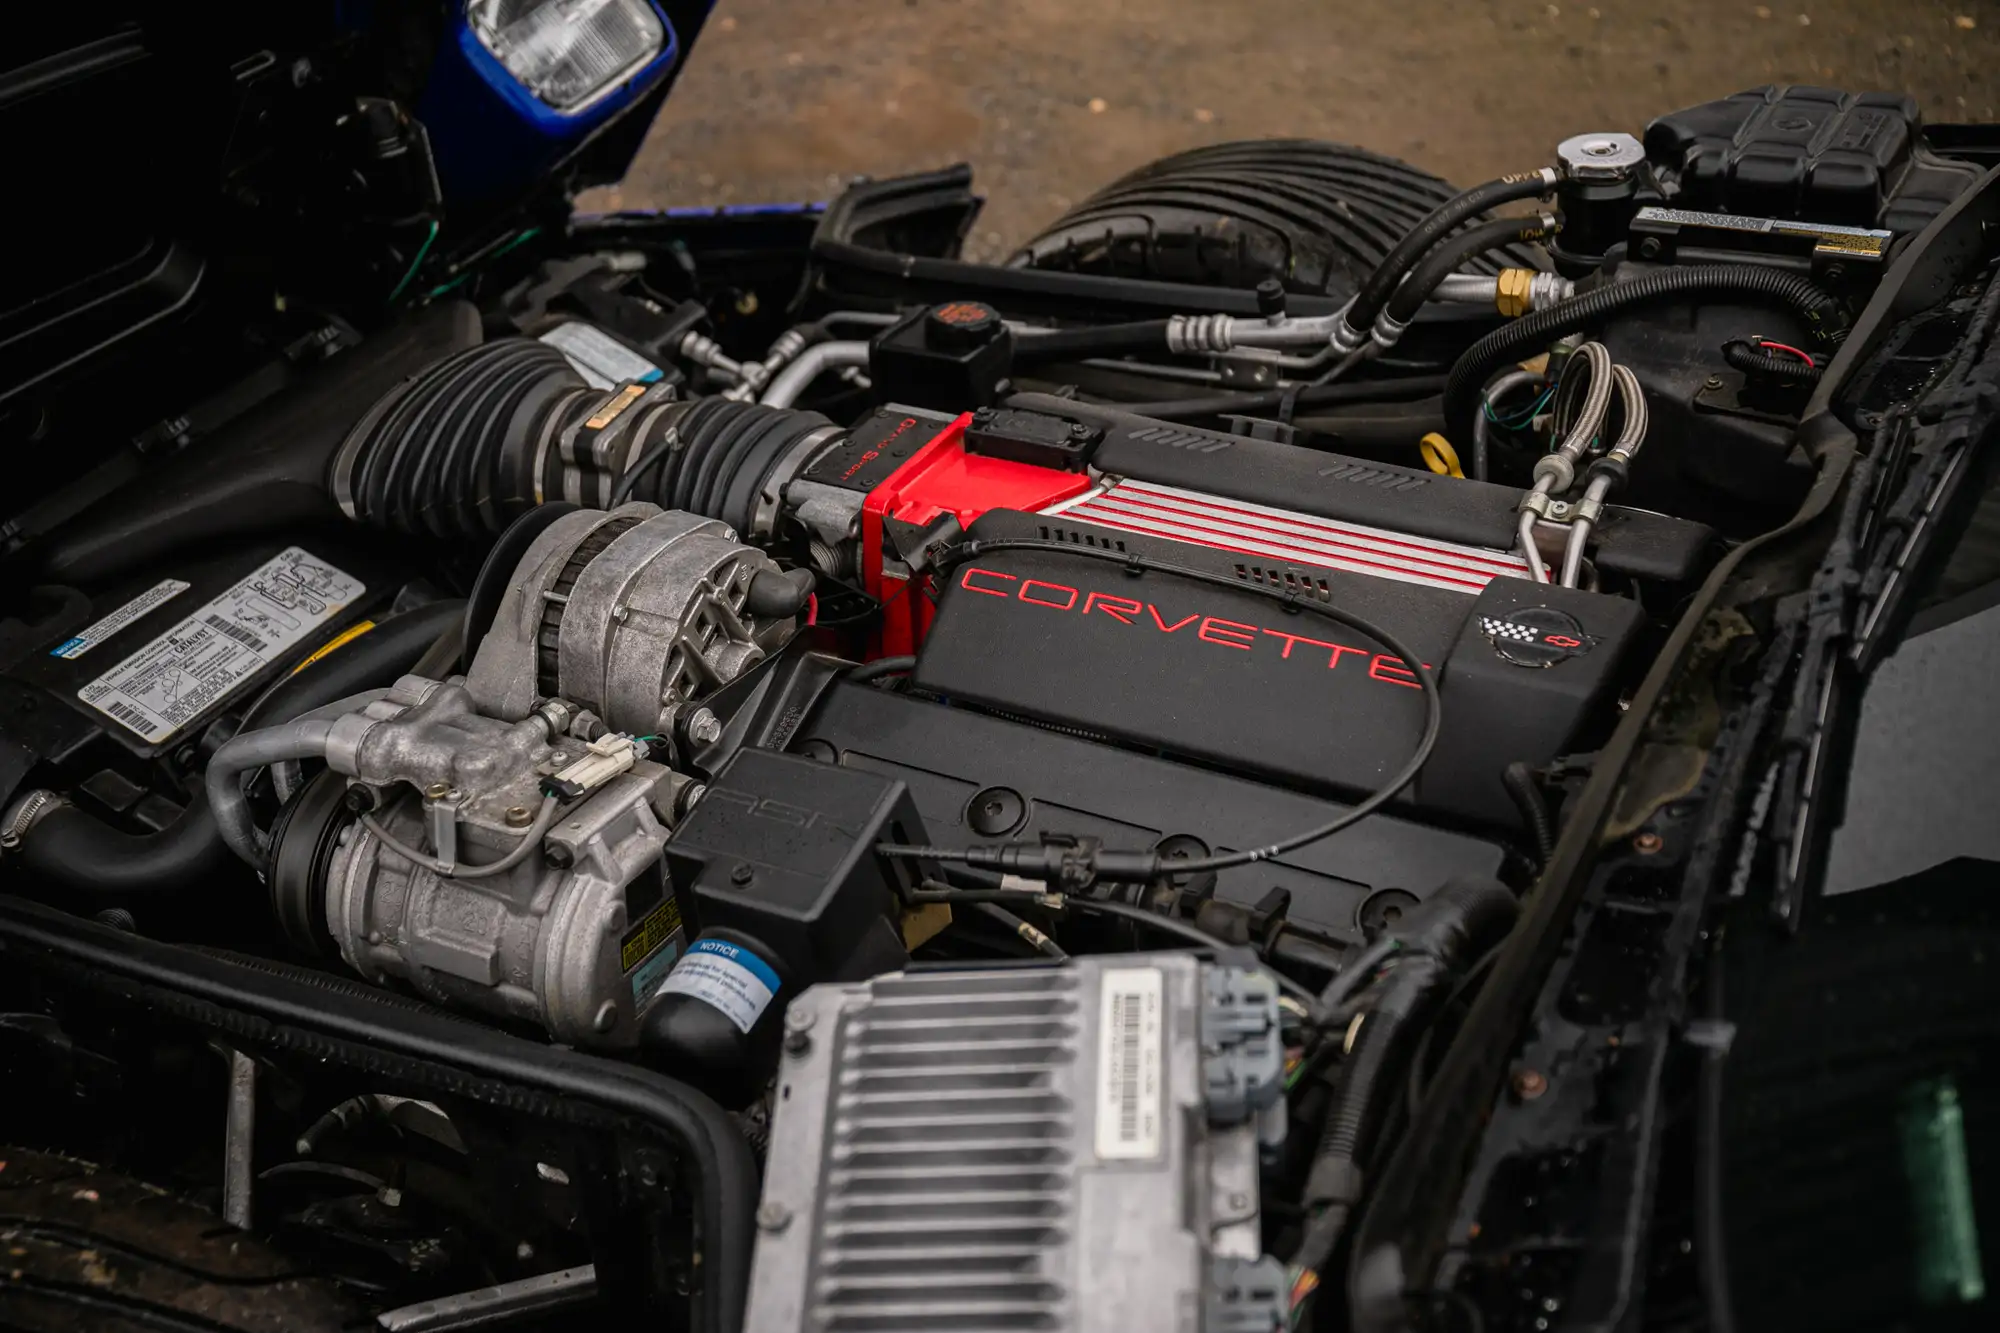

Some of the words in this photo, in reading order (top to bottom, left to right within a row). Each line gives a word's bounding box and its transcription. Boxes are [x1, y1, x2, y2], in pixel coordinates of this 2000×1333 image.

[1502, 169, 1541, 184] UPPE
[1519, 223, 1564, 241] LOWR
[961, 567, 1431, 689] CORVETTE
[174, 629, 208, 654] CATALYST
[700, 941, 740, 959] NOTICE
